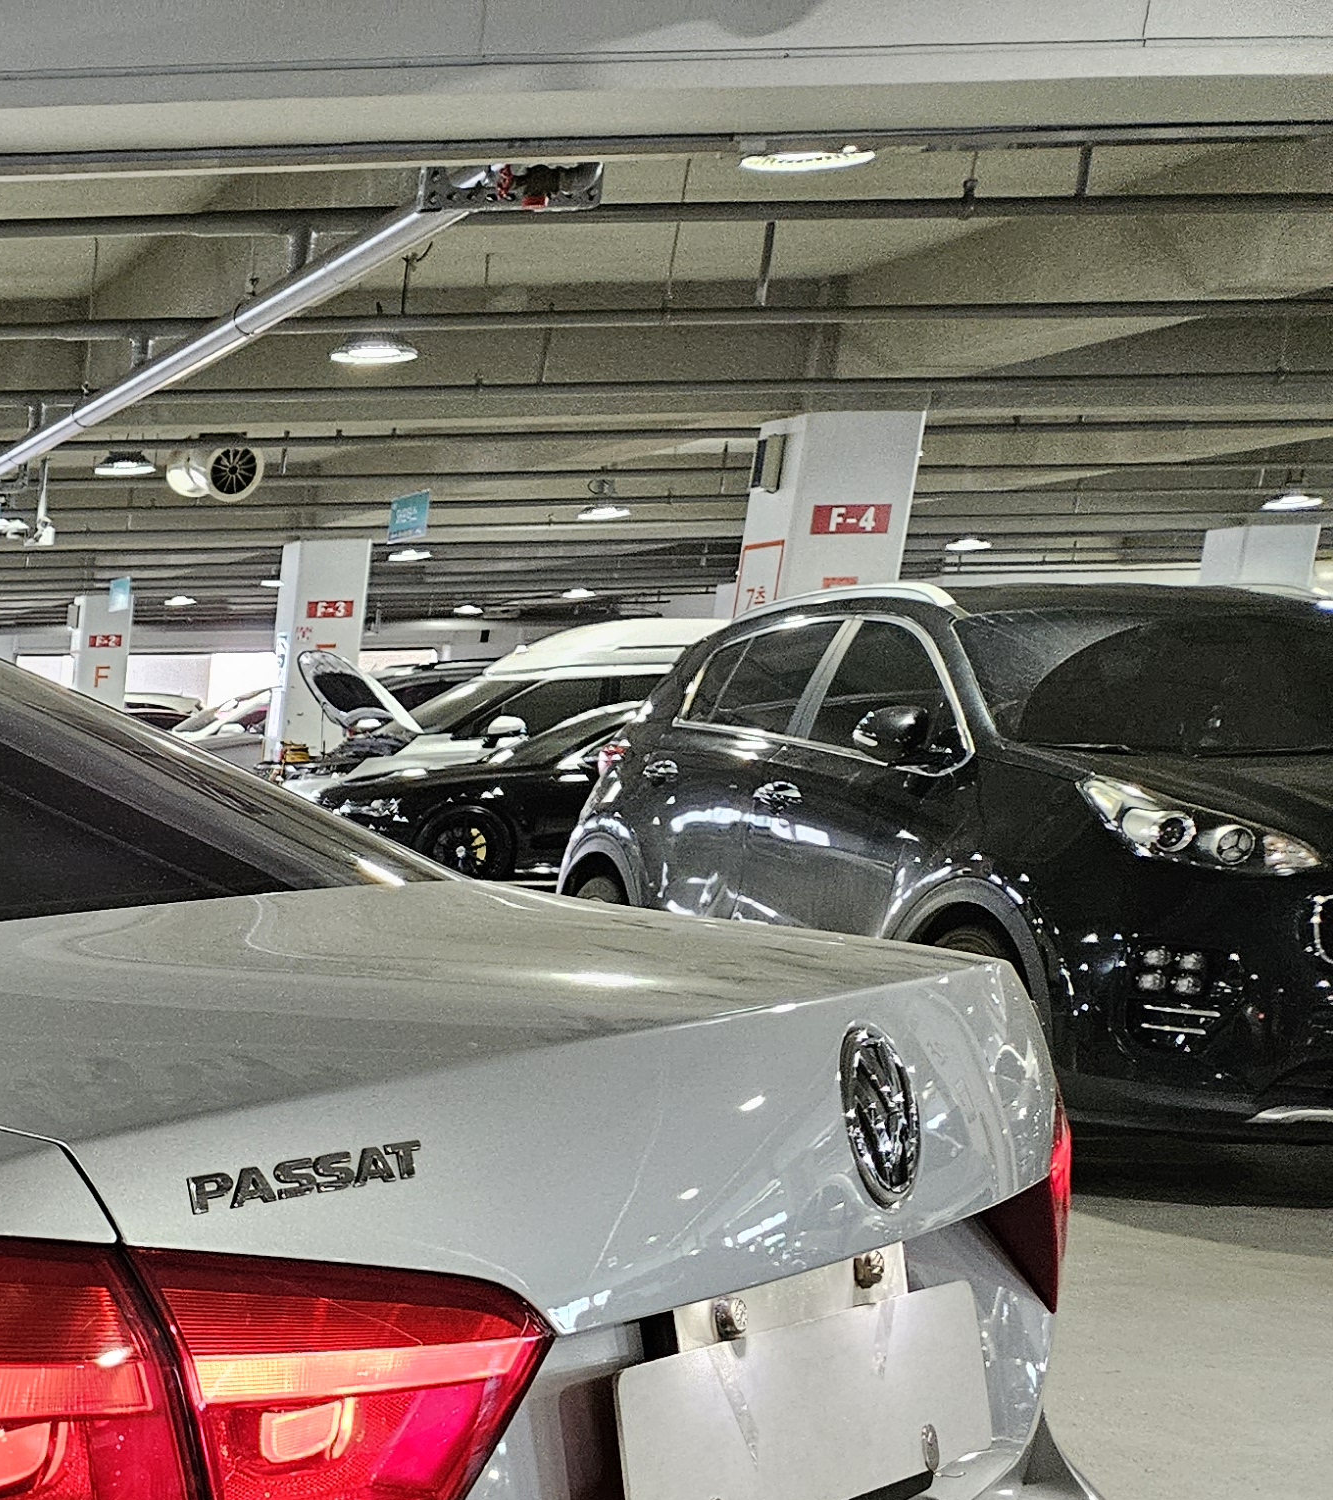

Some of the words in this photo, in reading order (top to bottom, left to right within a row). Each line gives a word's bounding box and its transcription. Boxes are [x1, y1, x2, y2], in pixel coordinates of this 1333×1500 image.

[829, 506, 876, 532] F-4
[316, 602, 346, 617] F-3
[96, 636, 117, 647] F-2
[94, 666, 110, 687] F
[186, 1140, 421, 1215] PASSAT
